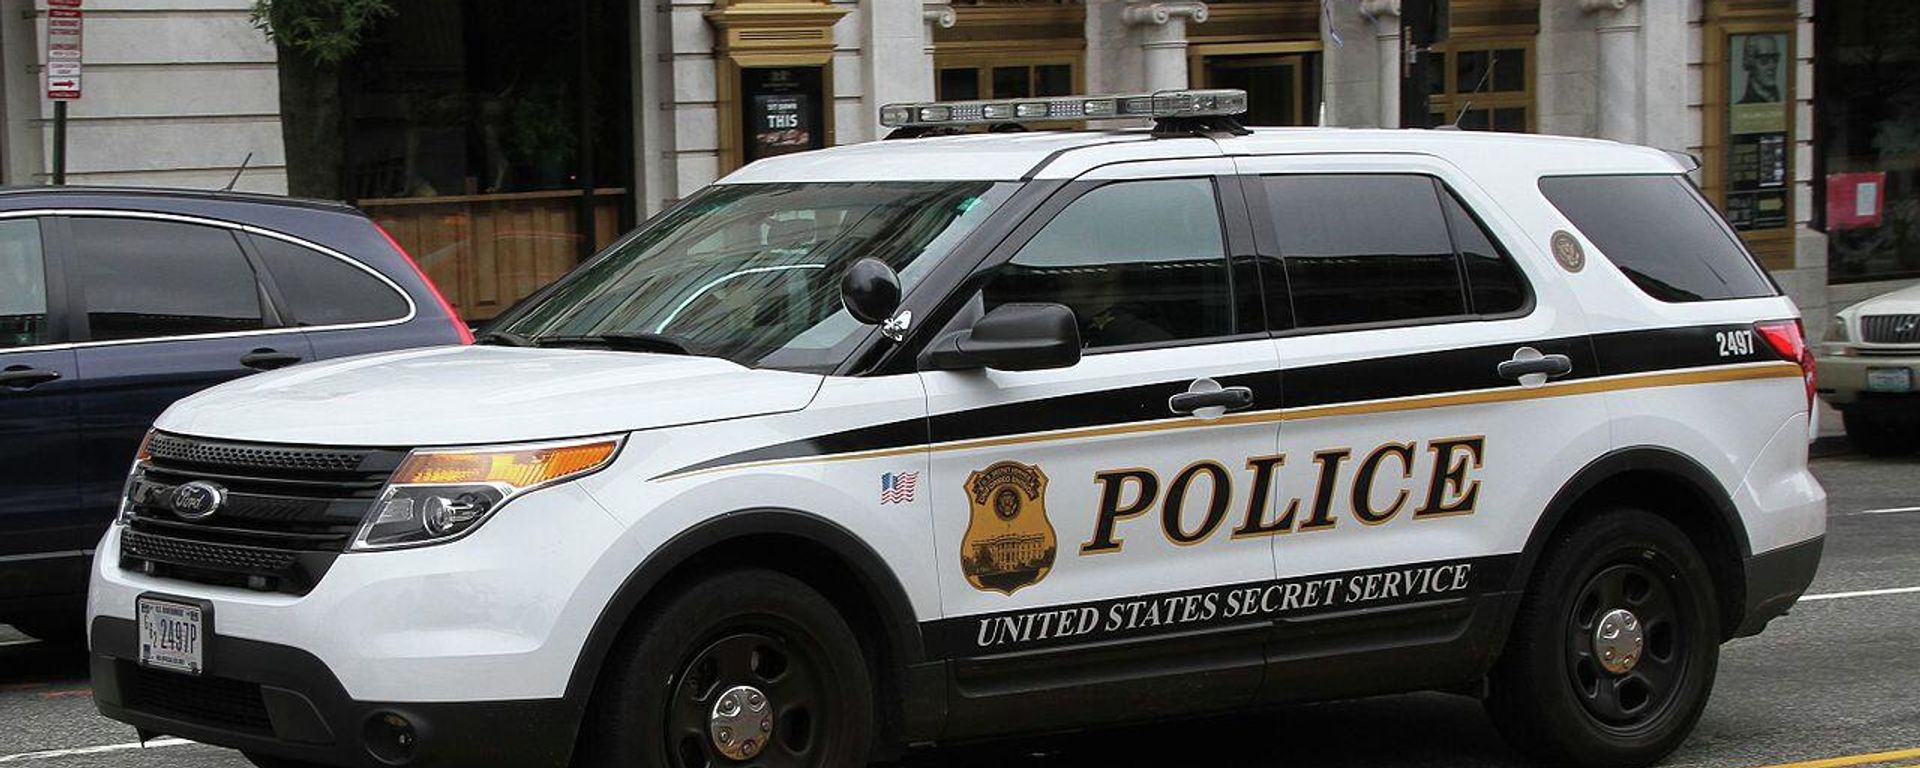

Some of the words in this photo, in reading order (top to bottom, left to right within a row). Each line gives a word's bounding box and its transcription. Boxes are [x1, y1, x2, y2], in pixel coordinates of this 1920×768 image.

[767, 114, 798, 128] THIS
[1715, 330, 1754, 356] 2497
[176, 486, 205, 508] Ford
[1079, 435, 1485, 556] POLICE
[977, 606, 1099, 647] UNITED
[1105, 592, 1220, 631] STATES
[1222, 578, 1343, 618] SECRET
[1345, 564, 1472, 603] SERVICE
[160, 618, 197, 654] 2497P
